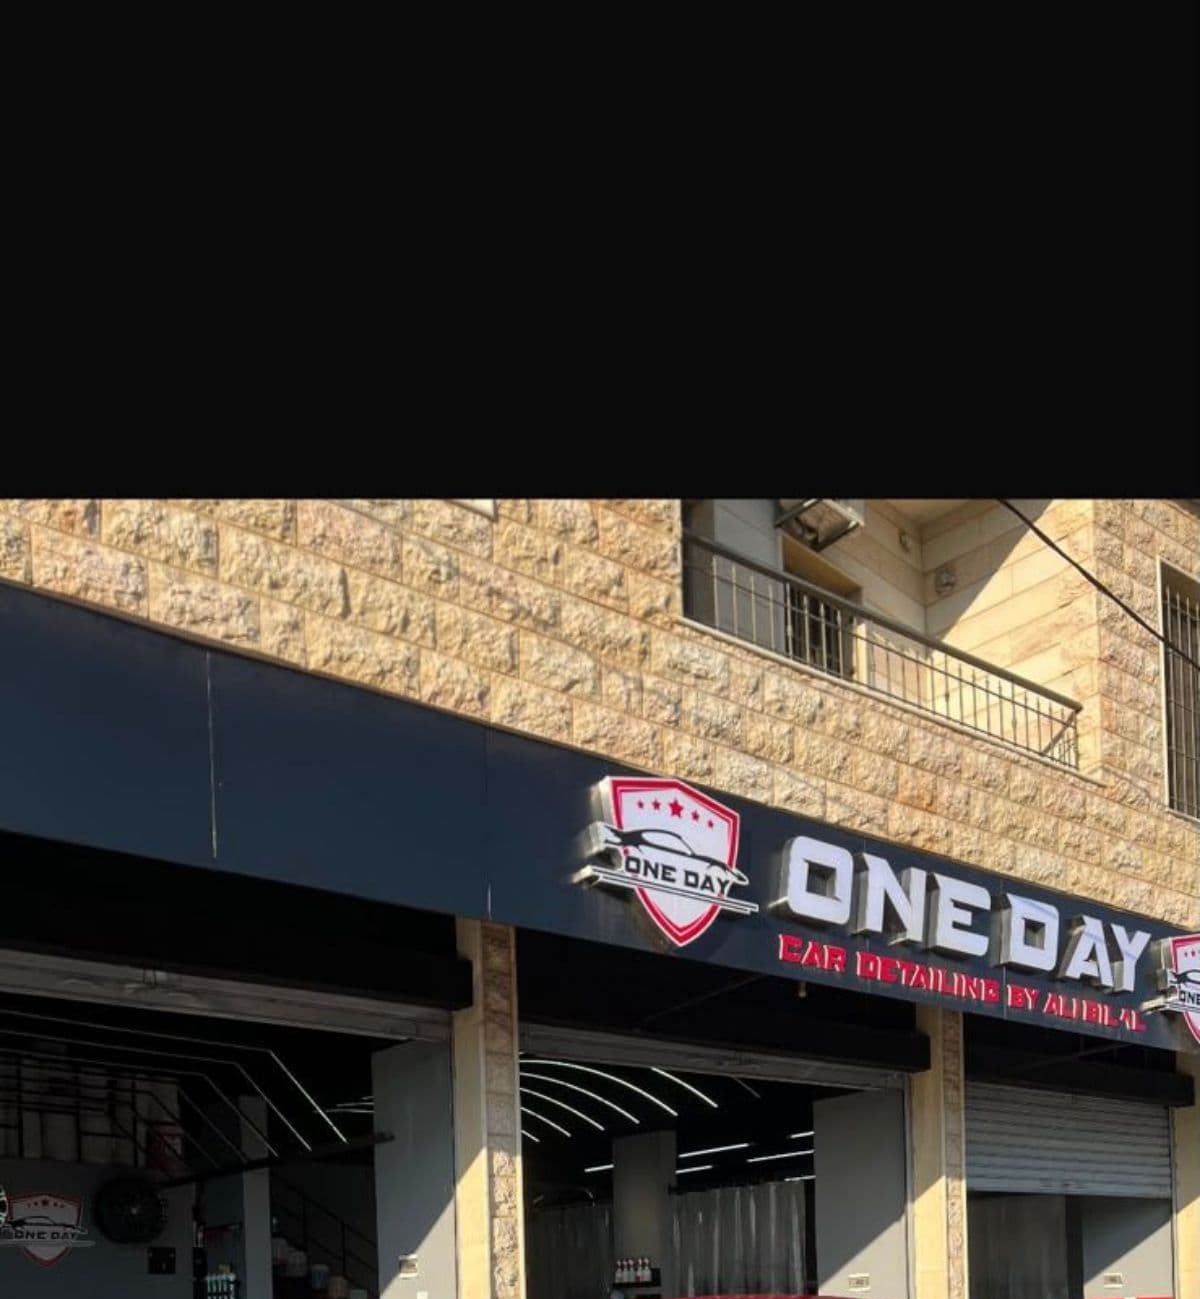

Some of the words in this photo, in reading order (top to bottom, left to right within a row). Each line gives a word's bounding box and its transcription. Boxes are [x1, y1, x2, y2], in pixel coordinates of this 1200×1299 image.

[625, 856, 676, 883] ONE
[684, 870, 729, 897] DAY
[783, 836, 990, 957] ONE
[1002, 894, 1151, 992] DAY
[778, 934, 847, 974] CAR
[856, 951, 1000, 1003] DETAILING
[1007, 984, 1039, 1012] BY
[14, 1229, 47, 1240] ONE
[51, 1231, 75, 1240] DAY
